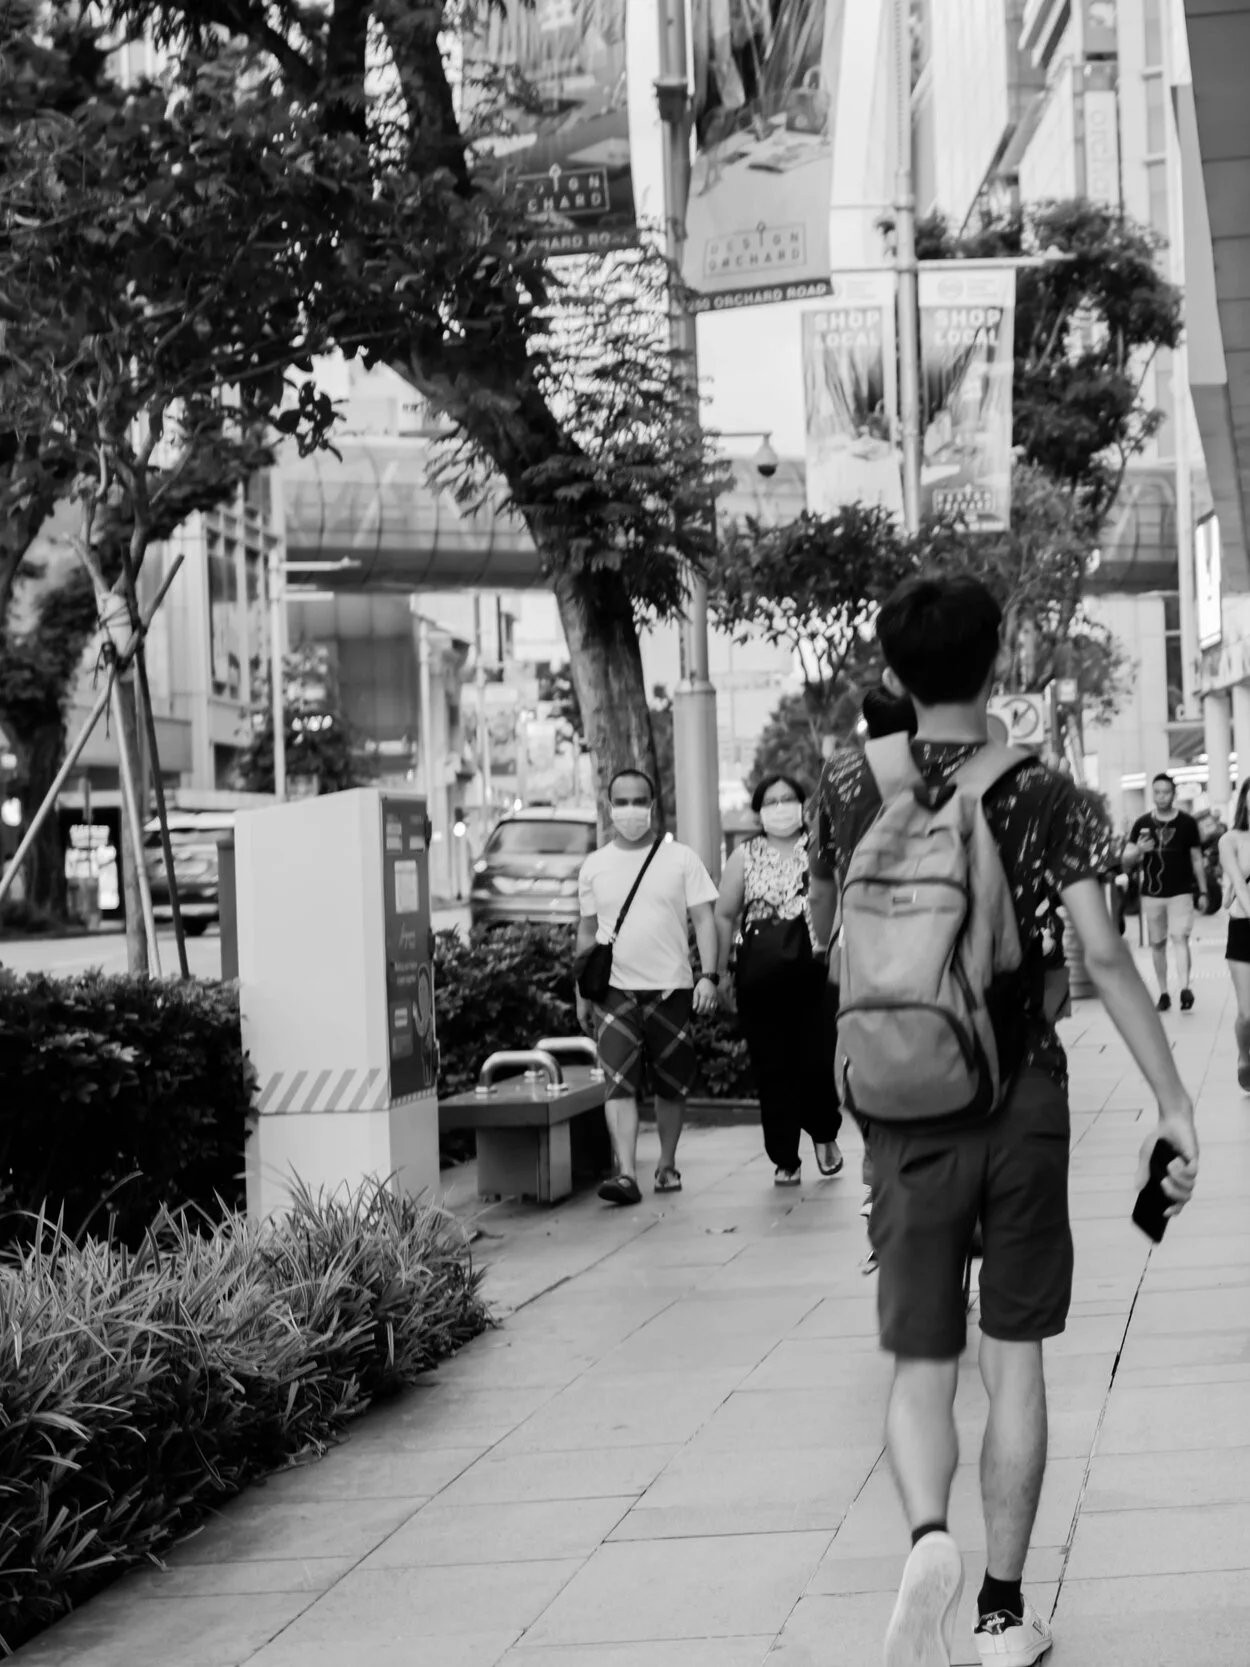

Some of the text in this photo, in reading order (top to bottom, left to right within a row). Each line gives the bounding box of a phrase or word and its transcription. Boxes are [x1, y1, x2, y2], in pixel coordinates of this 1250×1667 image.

[710, 221, 799, 255] DESIGN
[708, 248, 800, 271] ORCHARD
[713, 288, 783, 309] ORCHARD
[786, 282, 827, 299] ROAD
[813, 311, 880, 330] SHOP
[935, 308, 1000, 327] SHOP
[814, 332, 879, 349] LOCAL
[935, 327, 998, 346] LOCAL
